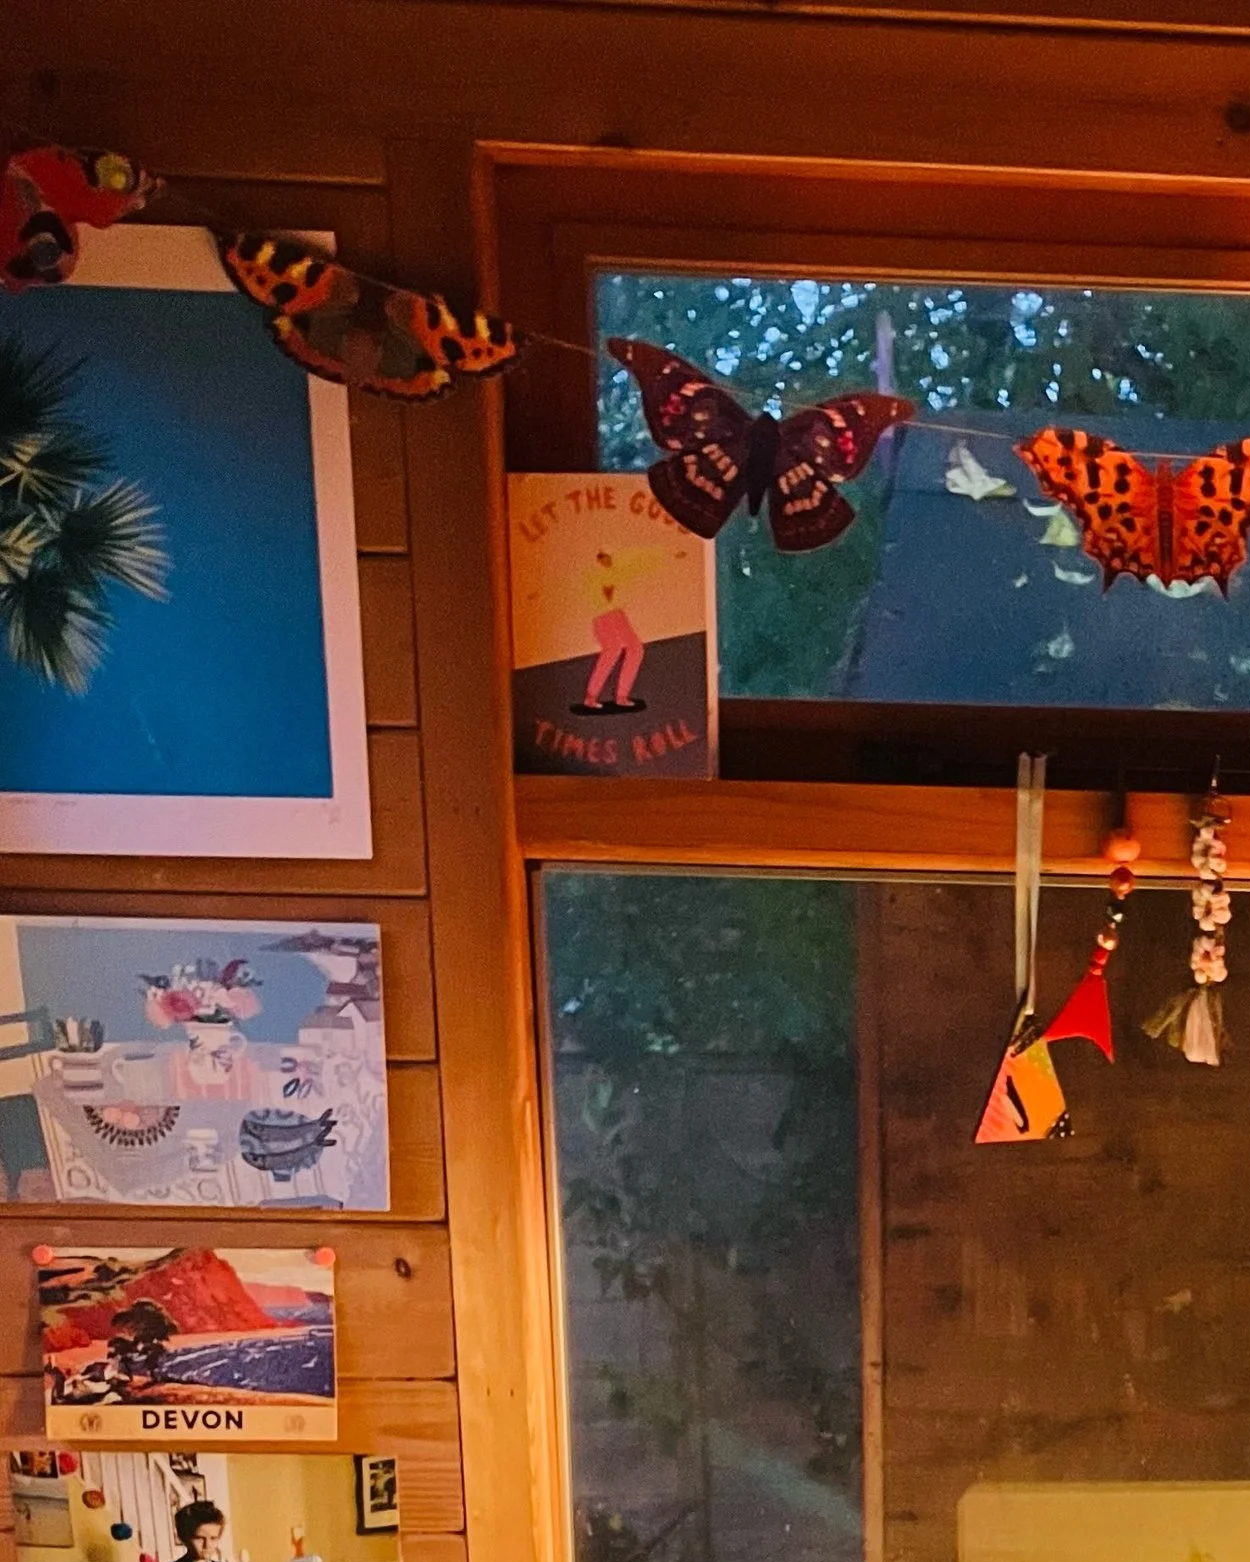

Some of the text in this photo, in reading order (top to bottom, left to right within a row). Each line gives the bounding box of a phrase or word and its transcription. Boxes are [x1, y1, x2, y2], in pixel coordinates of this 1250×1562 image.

[519, 486, 691, 543] LET THE GO
[535, 718, 698, 765] TIMES ROLL
[142, 1410, 243, 1430] DEVON
